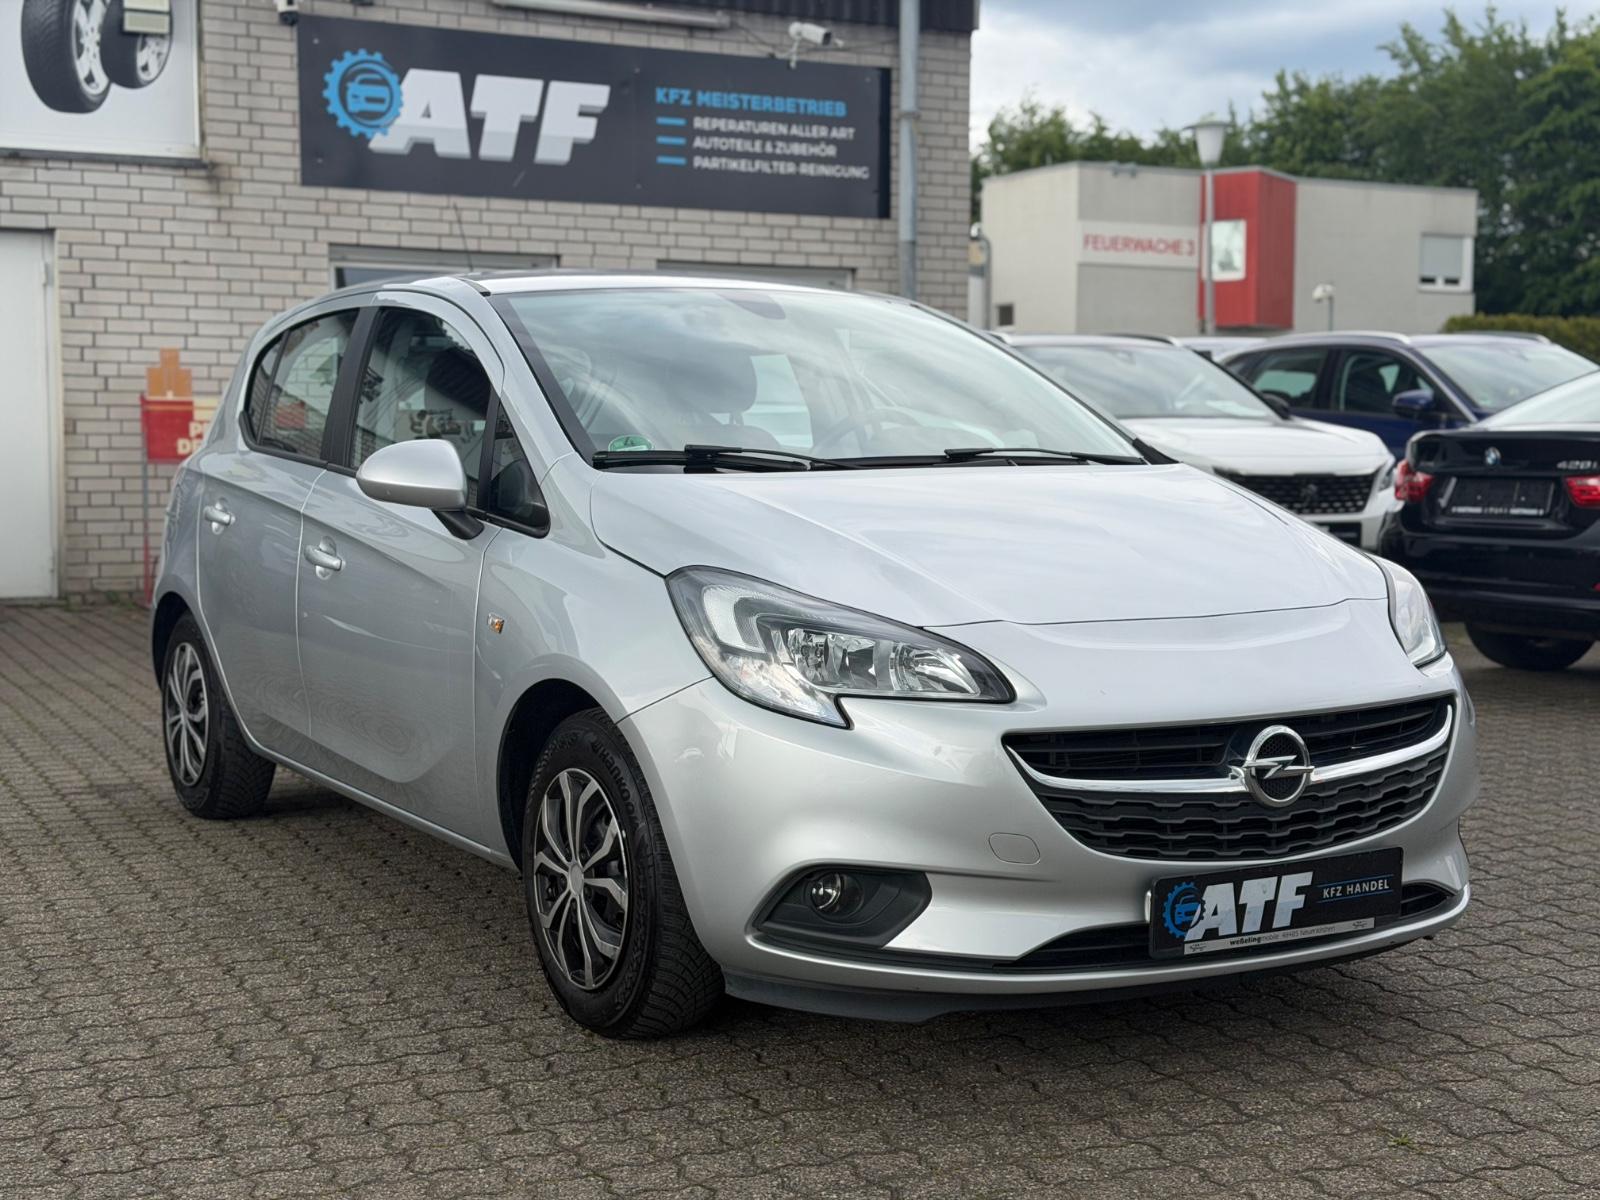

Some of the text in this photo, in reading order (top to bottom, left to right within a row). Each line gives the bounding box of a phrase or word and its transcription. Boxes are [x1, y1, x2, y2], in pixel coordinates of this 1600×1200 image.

[656, 87, 848, 117] KFZ MEISTERBETRIEB
[369, 68, 611, 166] ATF
[693, 117, 856, 140] REPERATUREN ALLER ART
[693, 137, 837, 157] AUTOTEILE & ZUBEHÖR
[1083, 233, 1183, 256] FEUERWACHE
[1323, 878, 1390, 899] KFZ HANDEL
[1184, 872, 1314, 942] ATF
